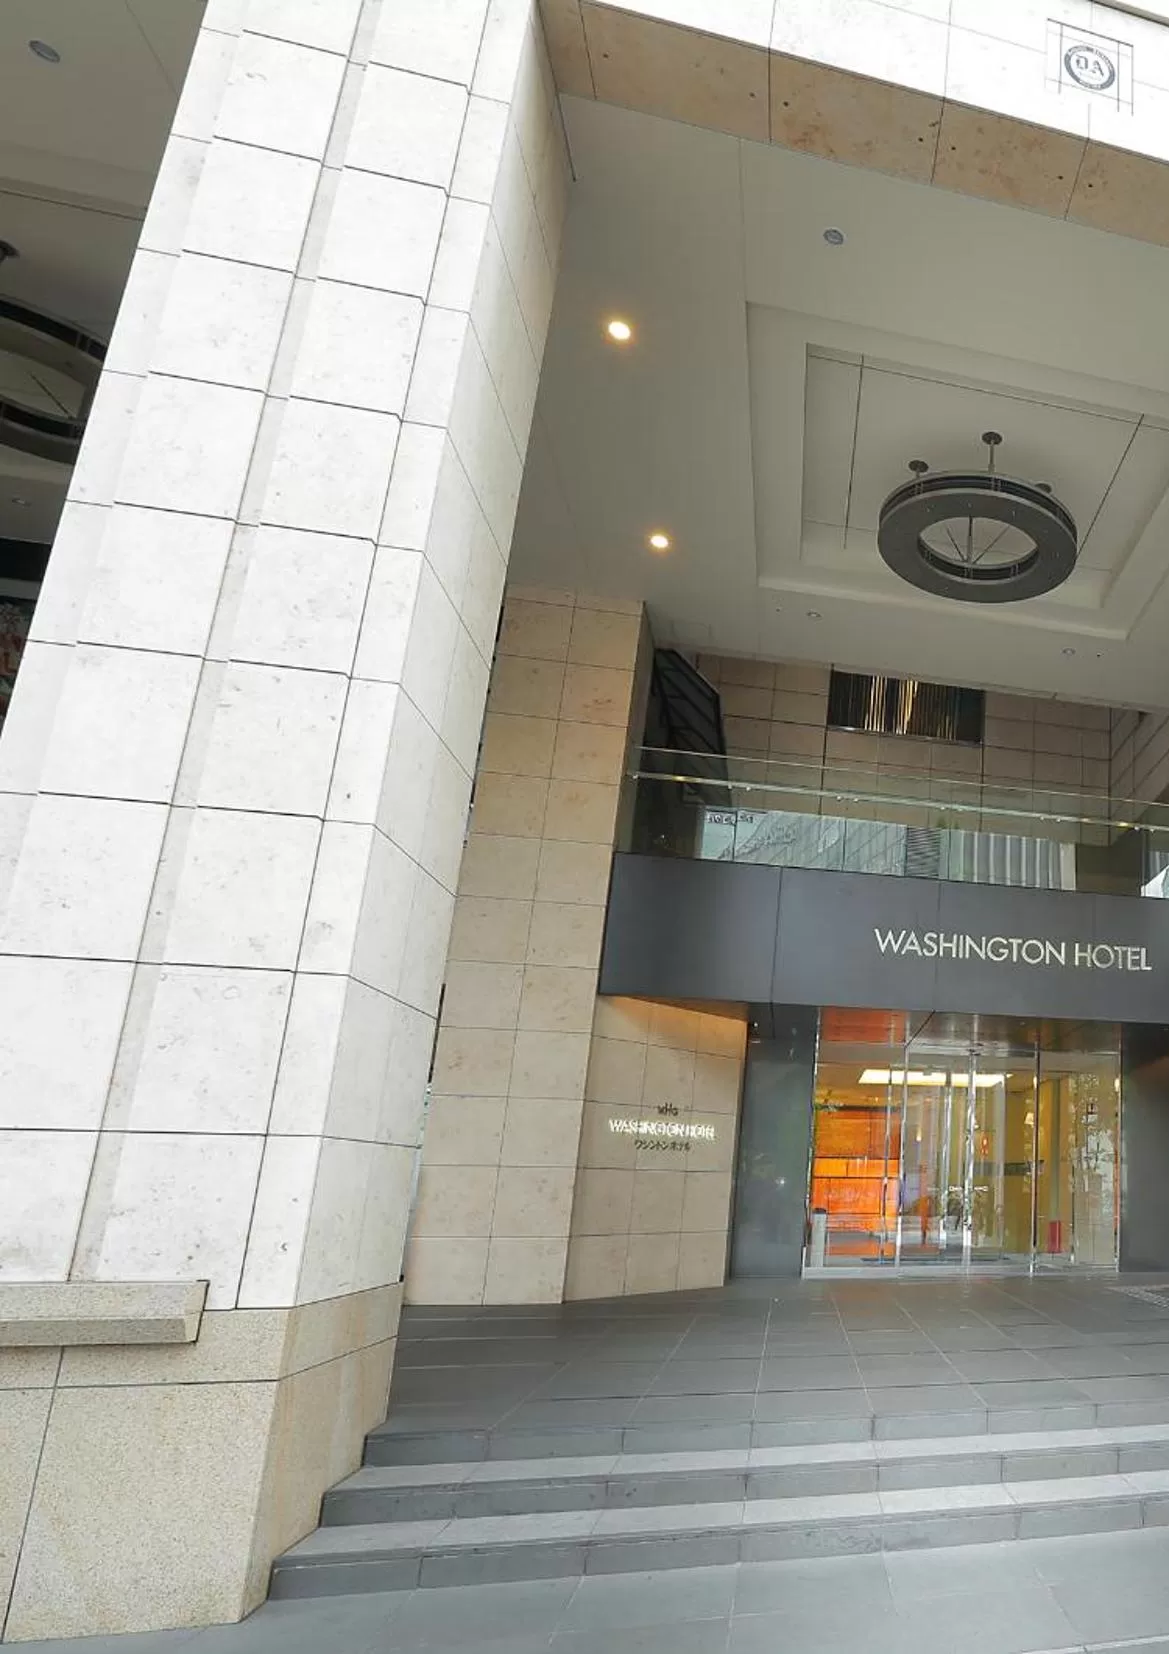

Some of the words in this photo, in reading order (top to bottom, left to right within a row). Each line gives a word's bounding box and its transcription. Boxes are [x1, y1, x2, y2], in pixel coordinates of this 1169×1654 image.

[874, 928, 1066, 965] WASHINGTON
[1074, 943, 1153, 971] HOTEL
[634, 1139, 691, 1152] ワシントンホテル
